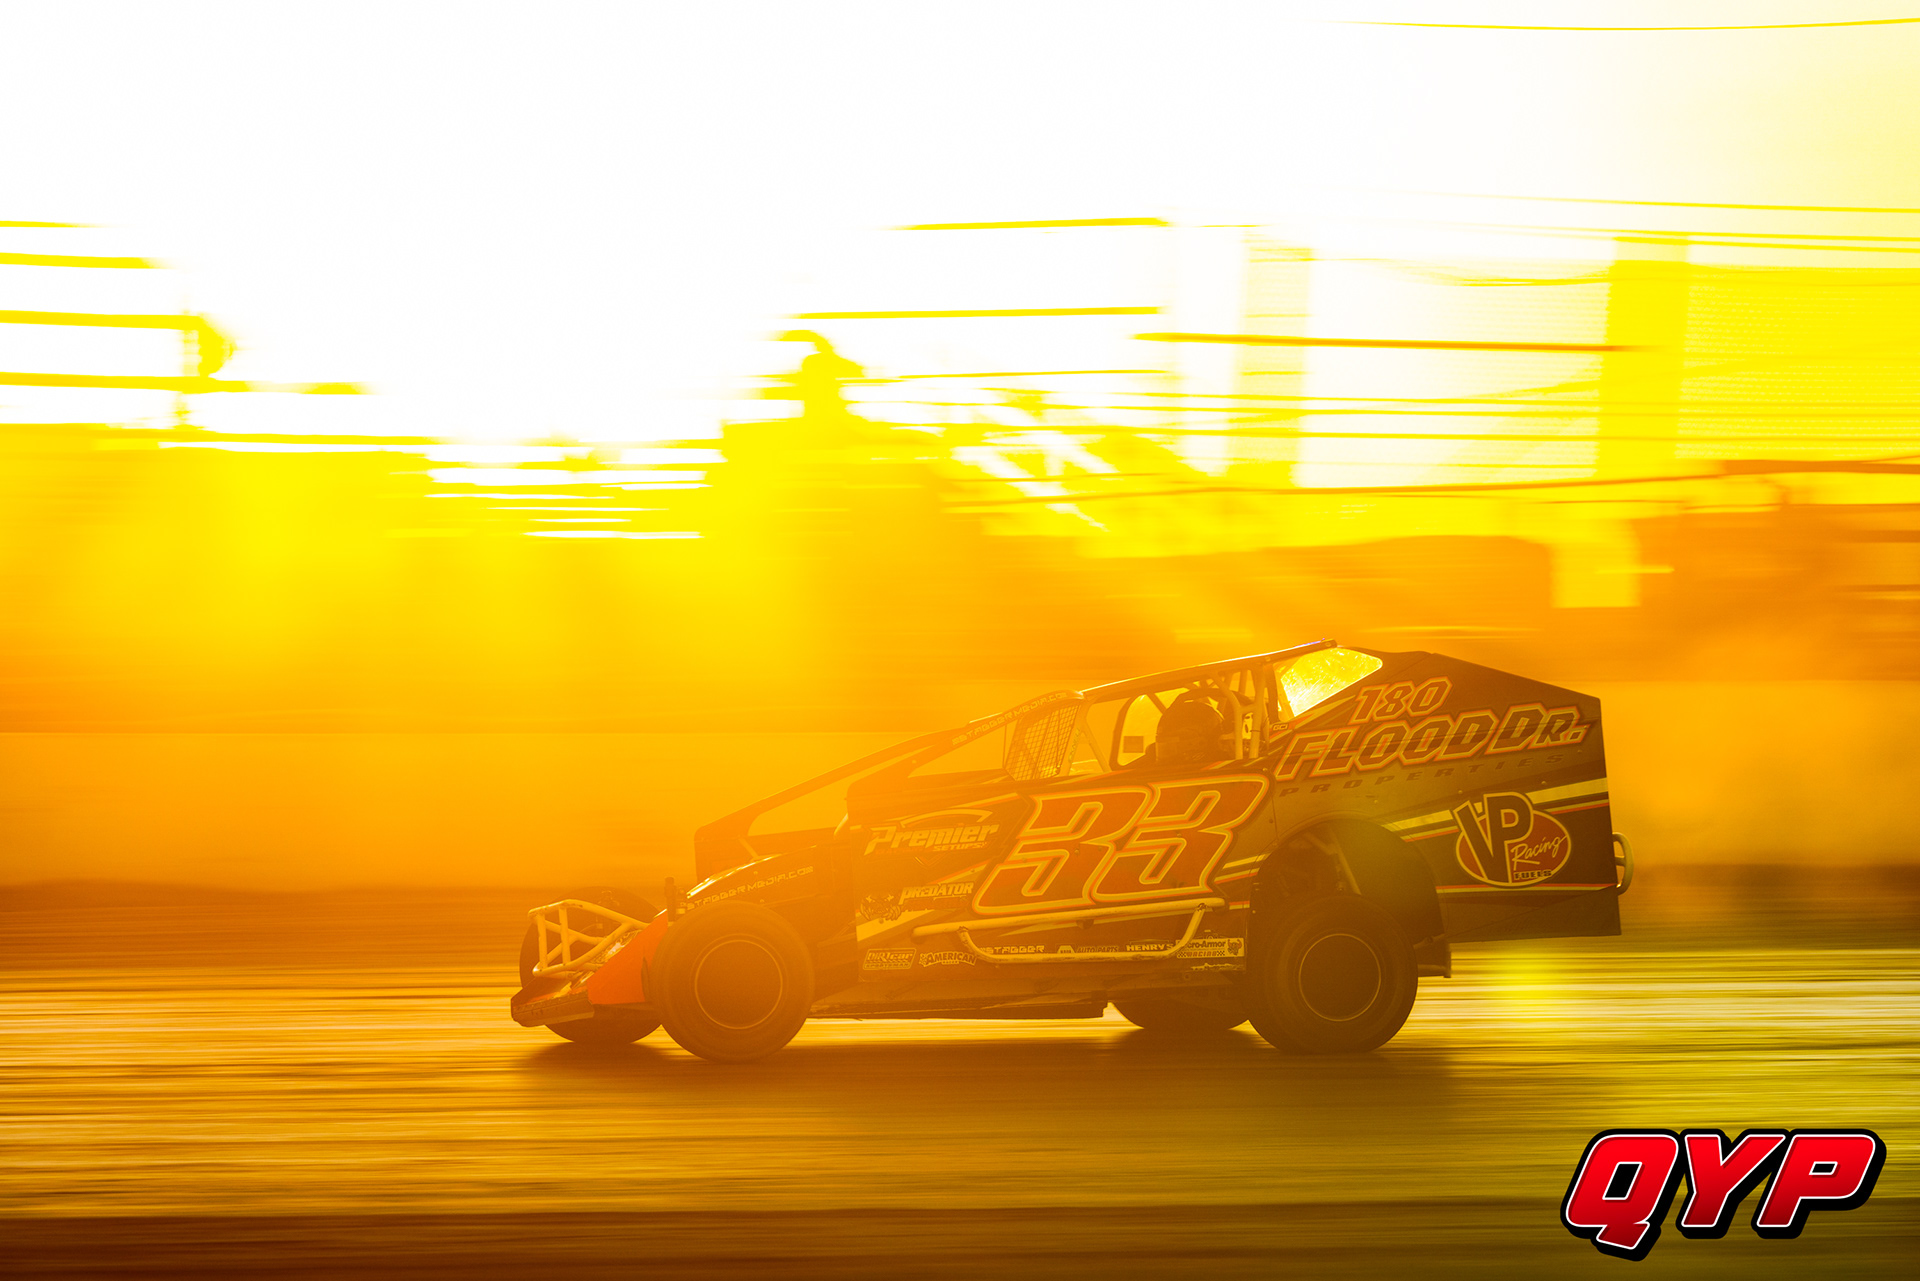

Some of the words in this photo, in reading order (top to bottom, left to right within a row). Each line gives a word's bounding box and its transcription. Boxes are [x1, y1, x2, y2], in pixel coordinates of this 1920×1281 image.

[1352, 676, 1453, 724] 180
[1274, 709, 1501, 781] FLOOD
[1279, 752, 1564, 798] PROPERTIES
[864, 823, 1000, 856] Premier
[973, 773, 1268, 915] 33
[1452, 791, 1535, 885] VP
[1510, 836, 1568, 871] Racing
[899, 881, 975, 905] PREDATOR
[1514, 870, 1554, 880] FUELS
[926, 952, 976, 966] AMERICAN
